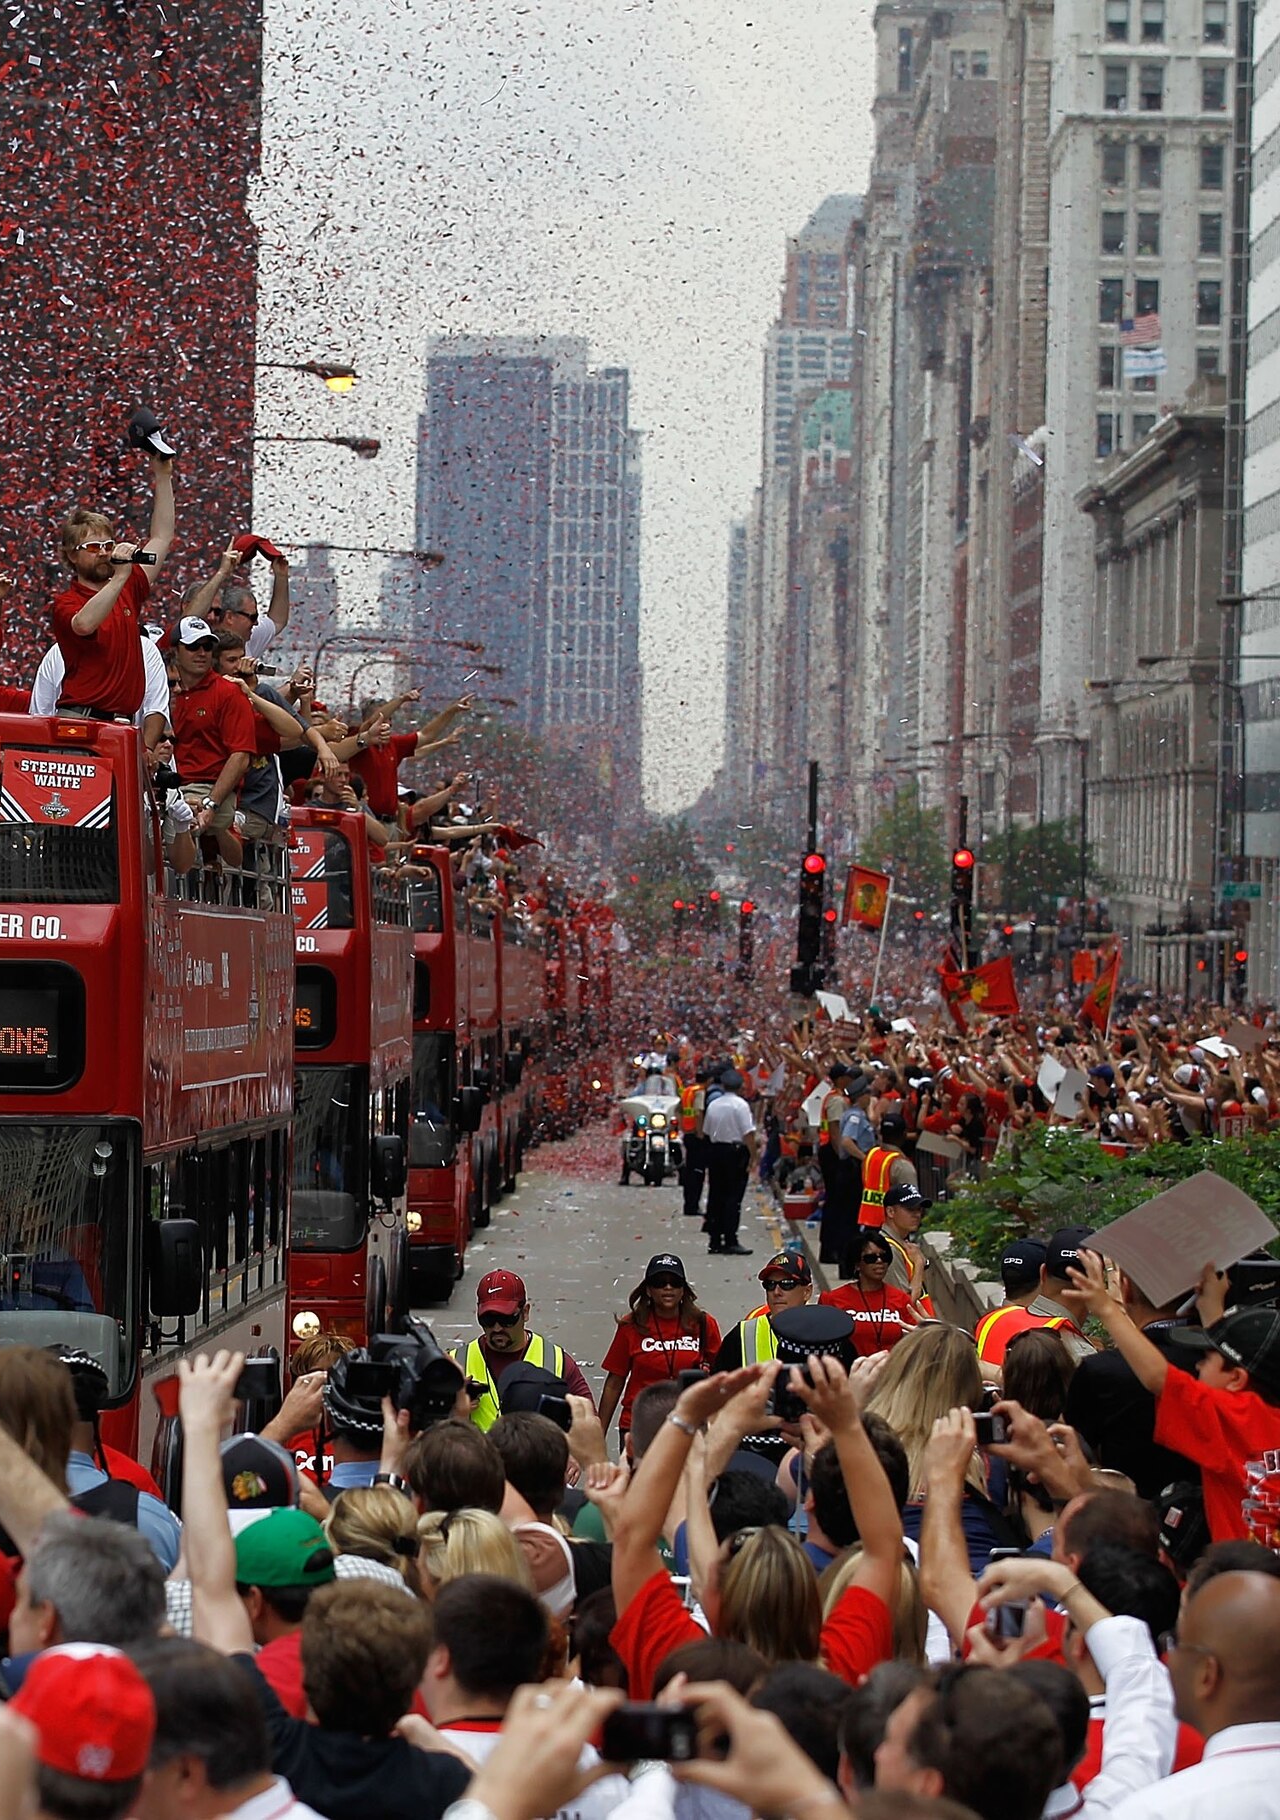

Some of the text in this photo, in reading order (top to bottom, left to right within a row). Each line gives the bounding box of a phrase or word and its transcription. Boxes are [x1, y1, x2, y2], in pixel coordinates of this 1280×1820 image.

[20, 759, 96, 777] STEPHANE
[33, 774, 81, 789] WAITE
[31, 914, 67, 940] CO.
[296, 936, 320, 953] CO.
[1003, 1257, 1023, 1265] CPD
[641, 1336, 700, 1353] ComEd
